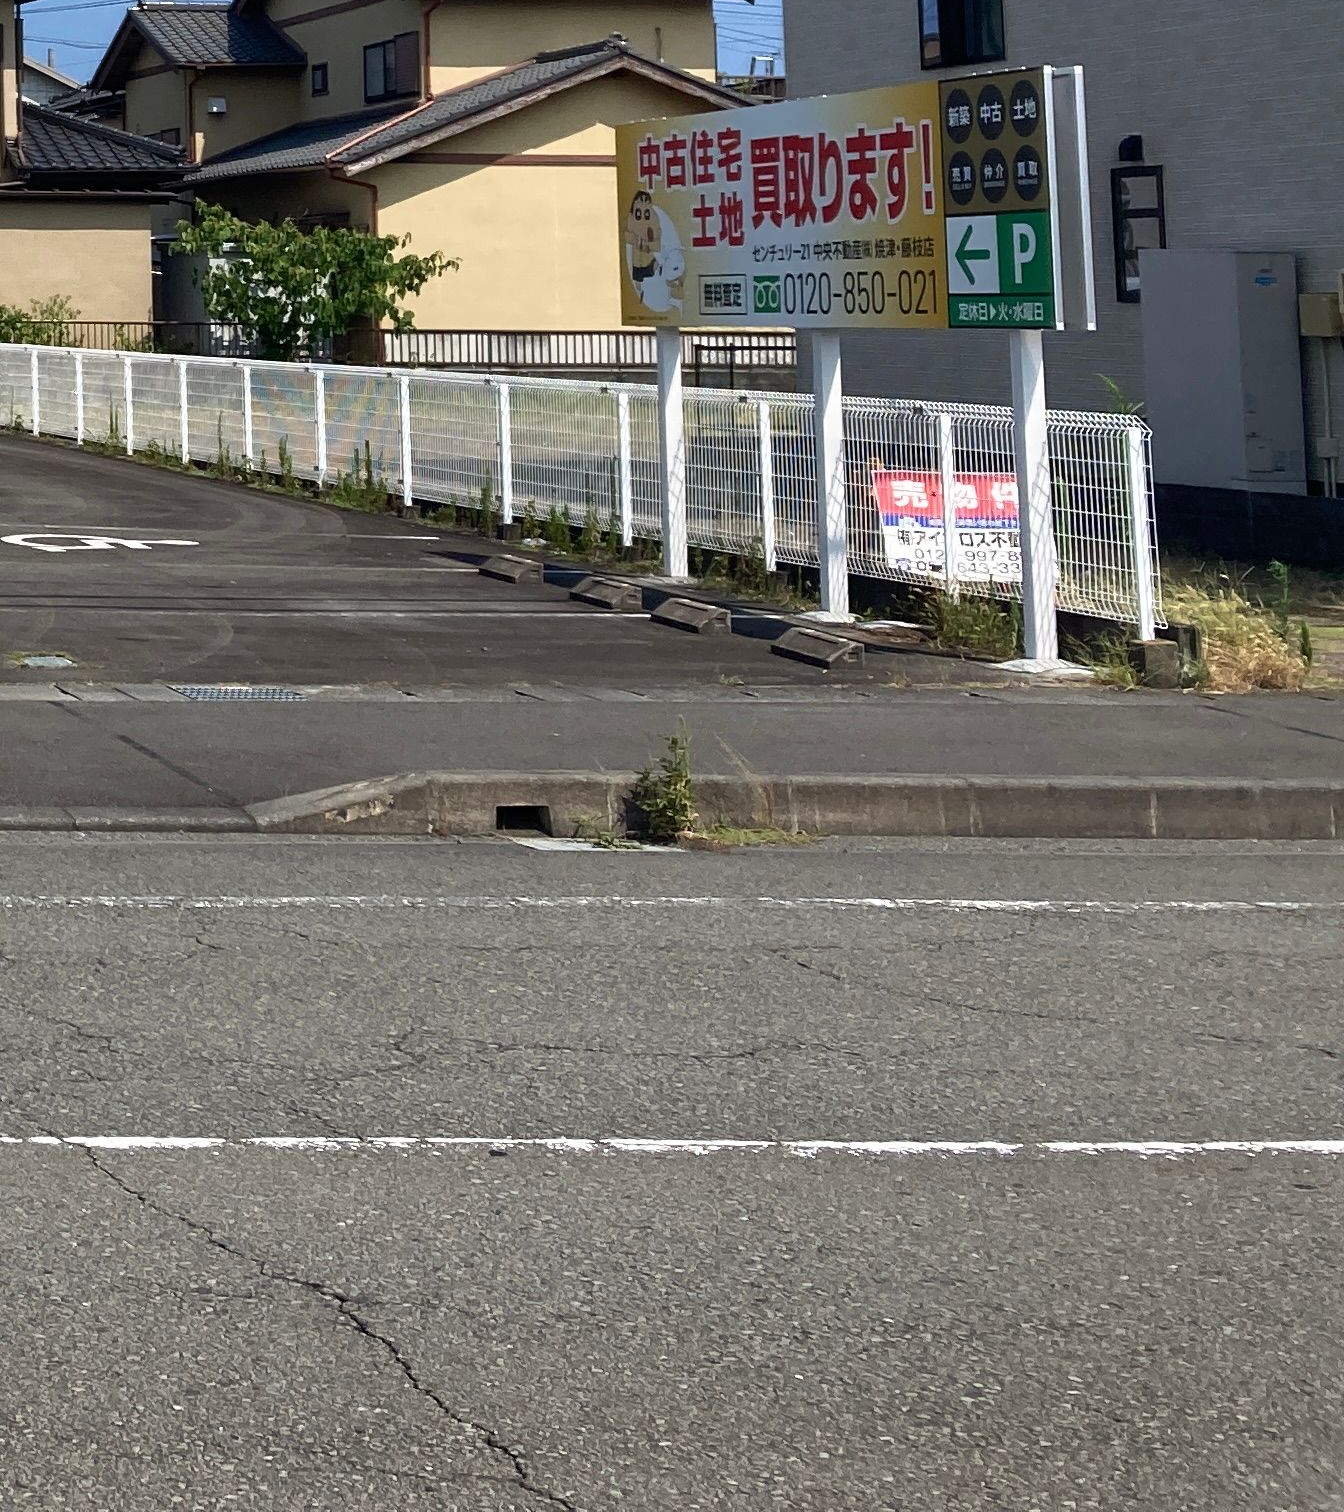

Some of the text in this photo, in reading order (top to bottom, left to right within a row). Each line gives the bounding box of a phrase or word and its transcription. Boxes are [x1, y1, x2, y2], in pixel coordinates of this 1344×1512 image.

[948, 105, 971, 127] 新築
[980, 101, 1002, 124] 中古
[1013, 97, 1037, 120] 土地
[639, 126, 743, 190] 中古住宅
[692, 192, 745, 248] 土地
[752, 243, 811, 263] センチュリー21
[1012, 222, 1037, 284] P
[783, 269, 939, 315] 0120-850-021
